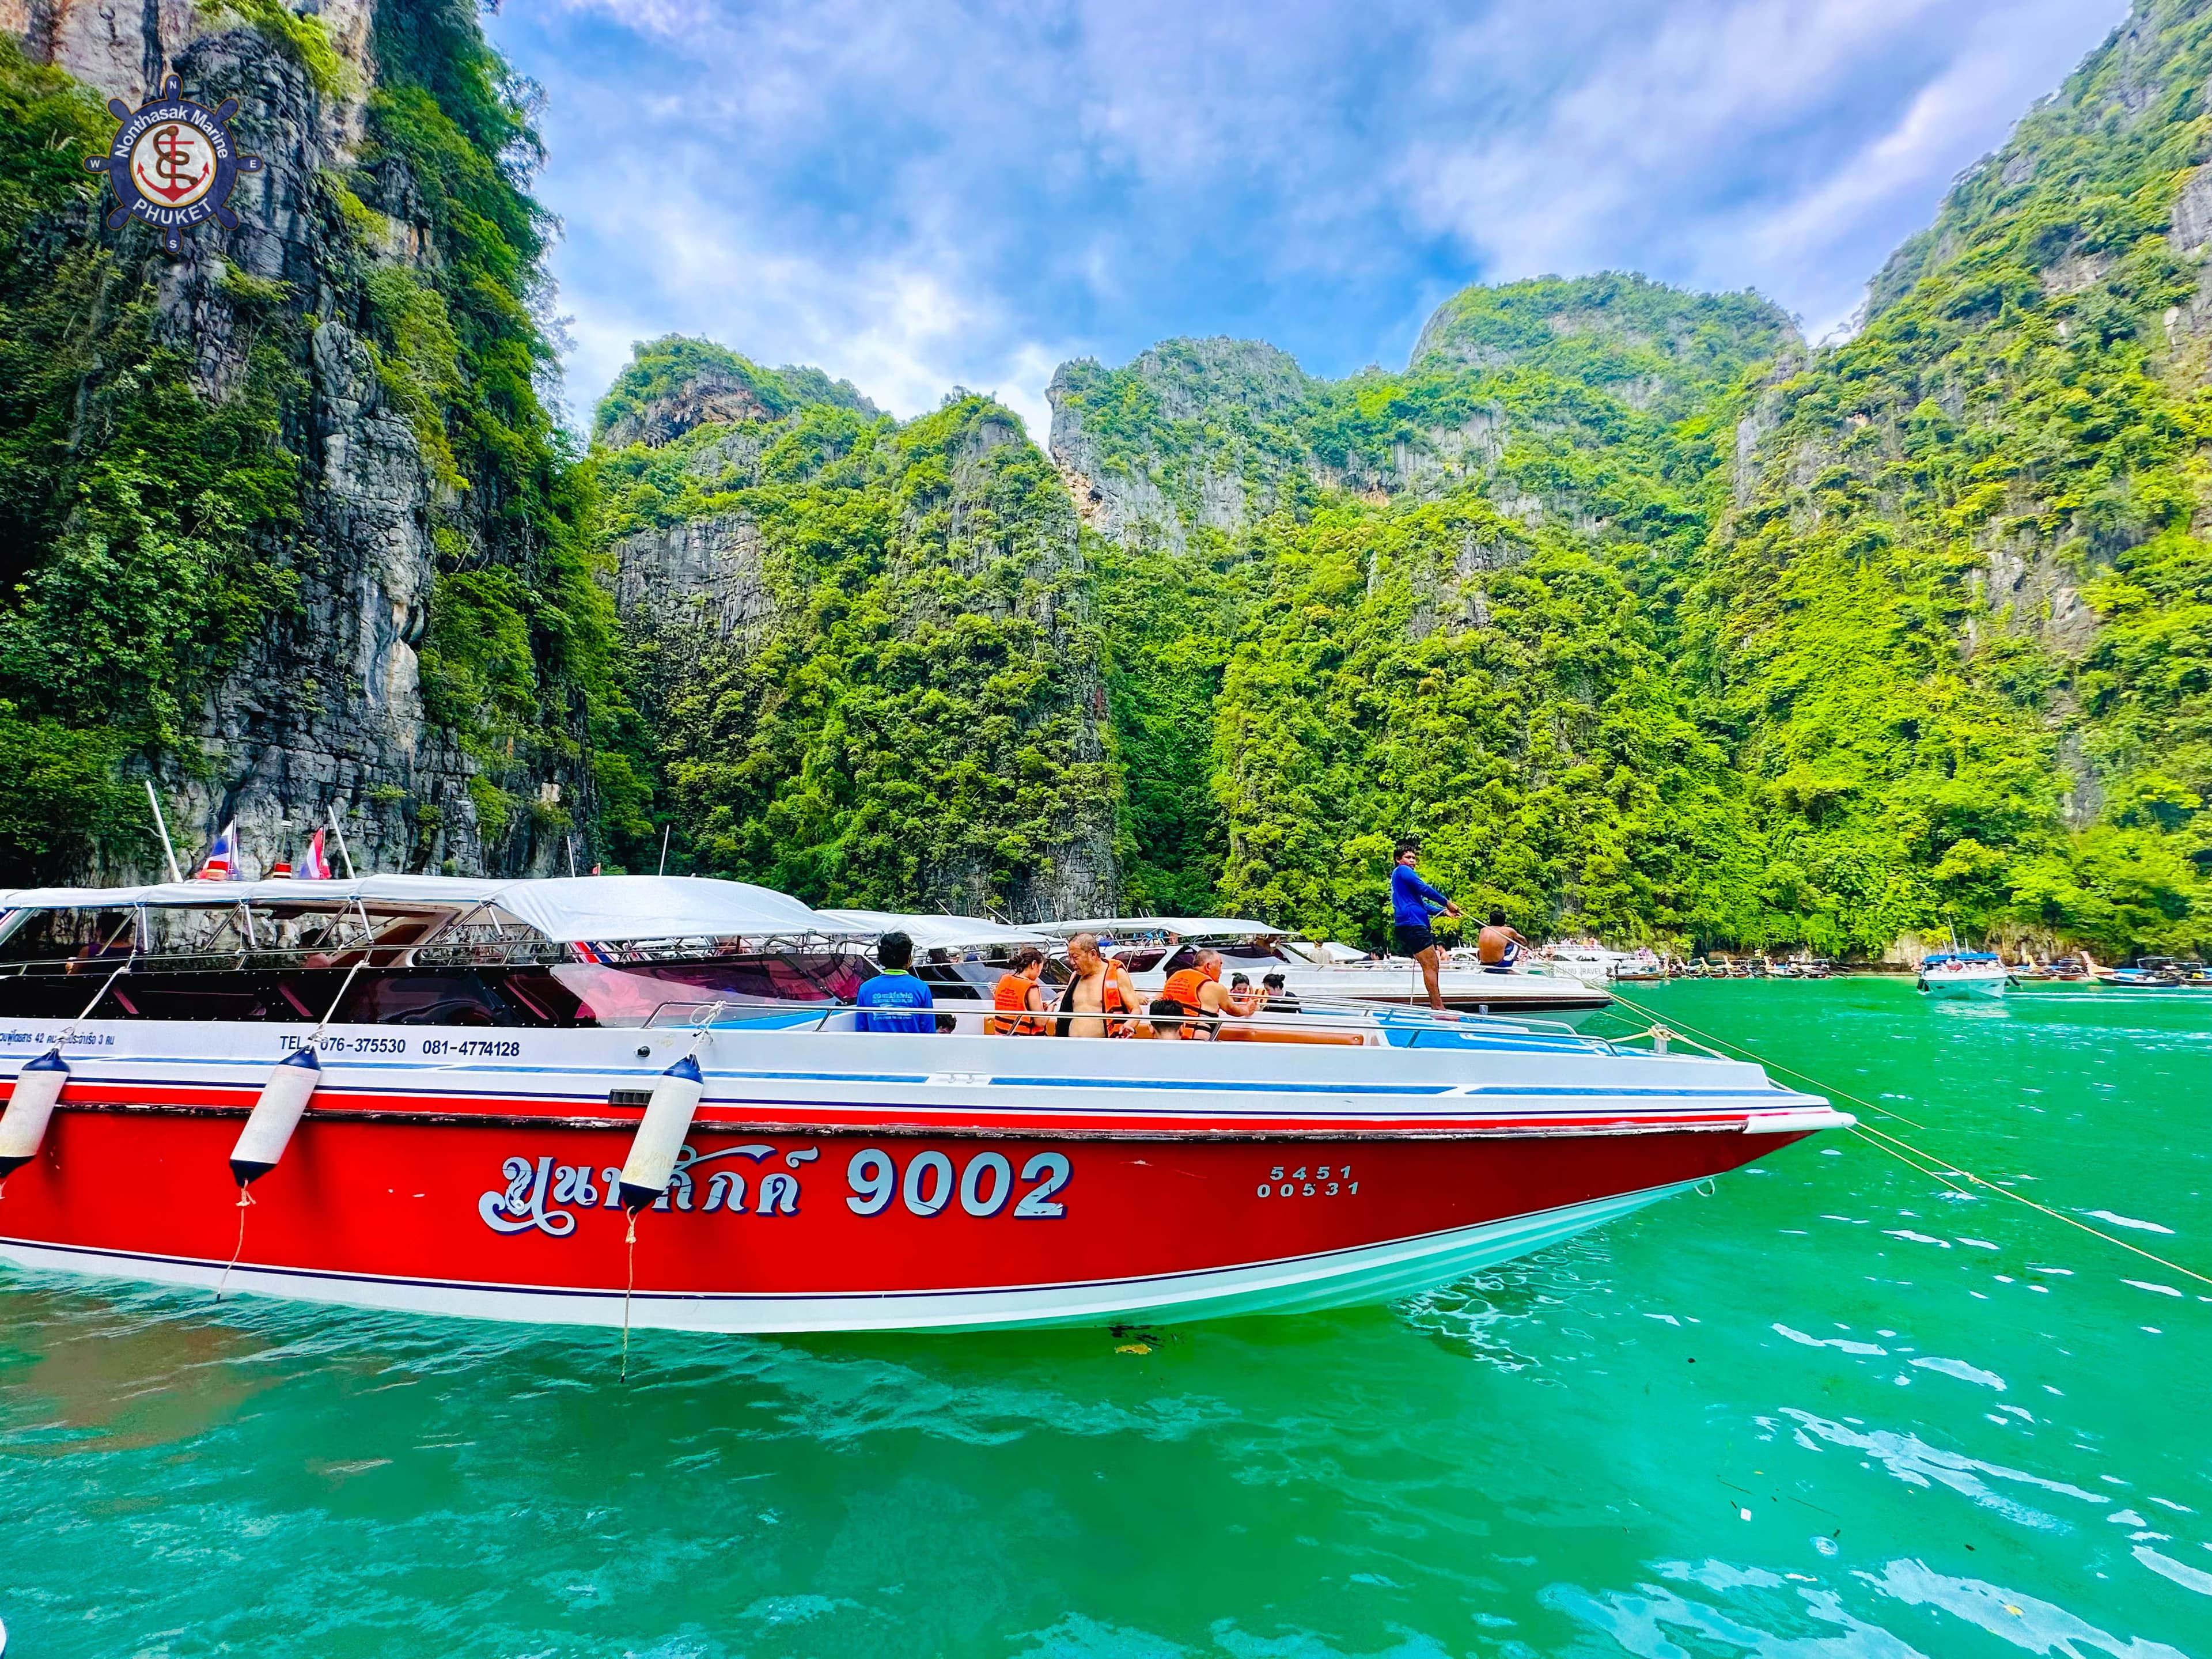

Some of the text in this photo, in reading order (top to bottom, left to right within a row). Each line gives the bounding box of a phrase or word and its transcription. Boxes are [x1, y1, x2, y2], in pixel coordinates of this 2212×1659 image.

[35, 1032, 44, 1043] 42
[99, 1034, 103, 1044] 3
[320, 1036, 406, 1054] 076-375530
[422, 1040, 520, 1056] 081-4774128
[1270, 1165, 1351, 1180] 5451
[846, 1148, 1073, 1218] 9002
[1256, 1181, 1359, 1198] 00531
